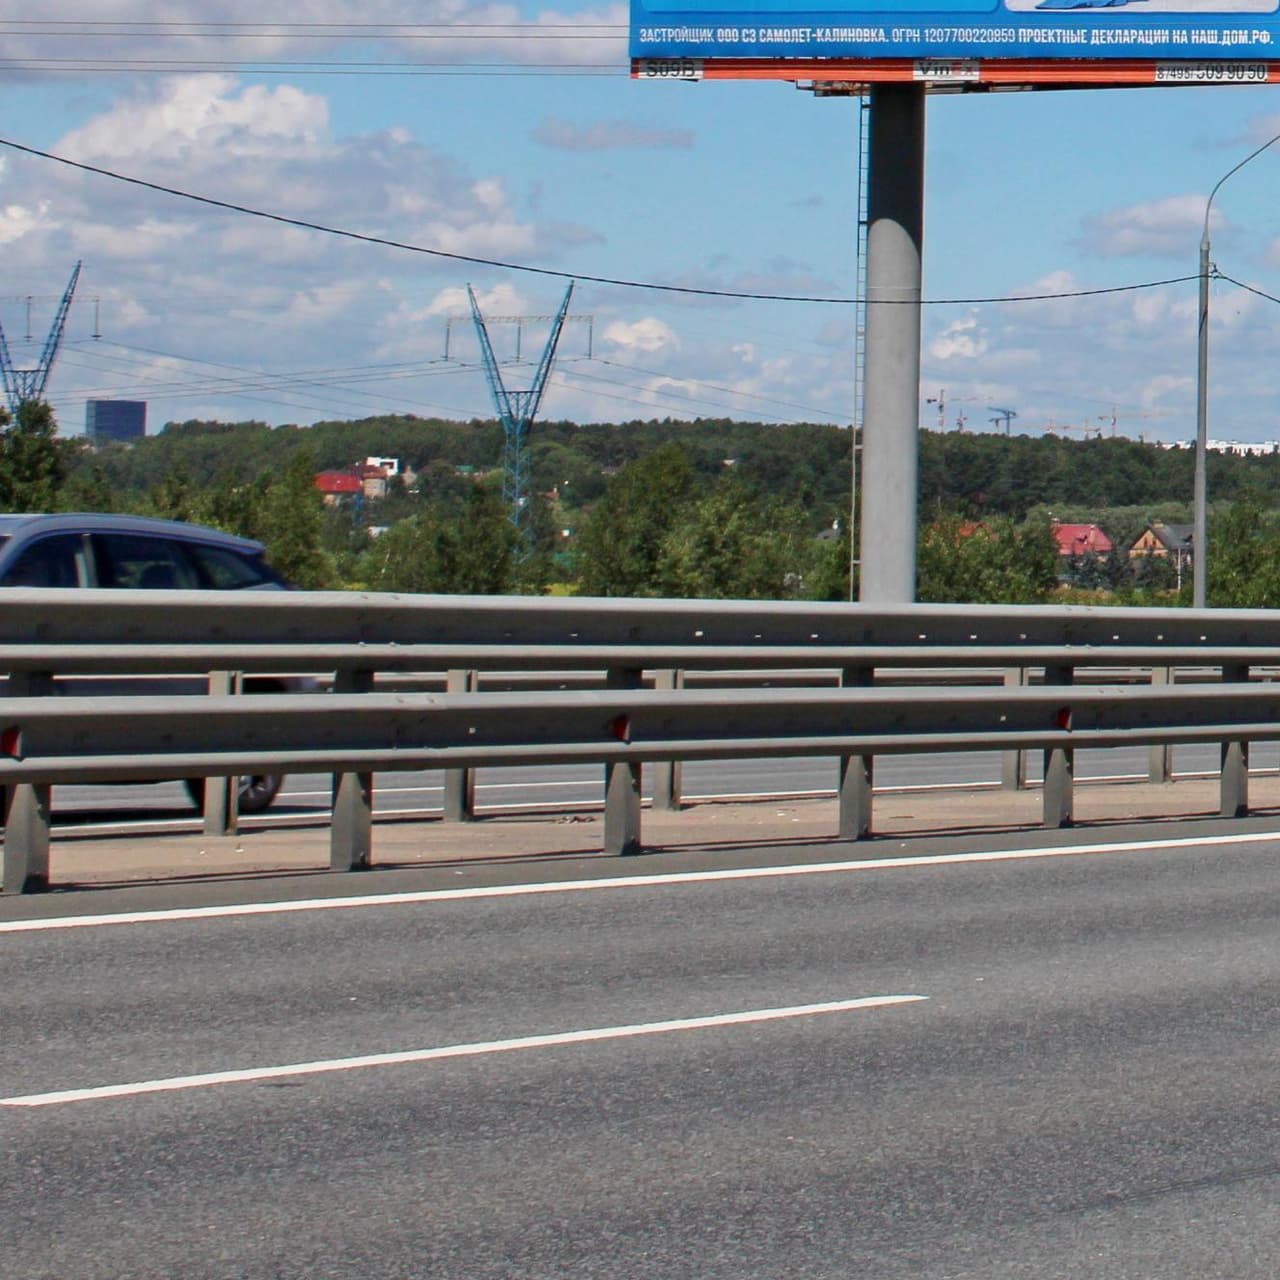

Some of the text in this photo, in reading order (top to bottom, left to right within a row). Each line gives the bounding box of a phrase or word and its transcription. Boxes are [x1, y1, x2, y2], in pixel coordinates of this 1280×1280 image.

[639, 26, 715, 44] ЗАСТРОЙЩИК
[759, 28, 889, 44] САМОЛЕТ-КАЛИНОВКА.
[892, 28, 921, 43] ОГРН
[1018, 28, 1088, 44] ПРОЕКТНЫЕ
[1090, 28, 1170, 46] ДЕКЛАРАЦИИ
[1172, 29, 1189, 44] НА
